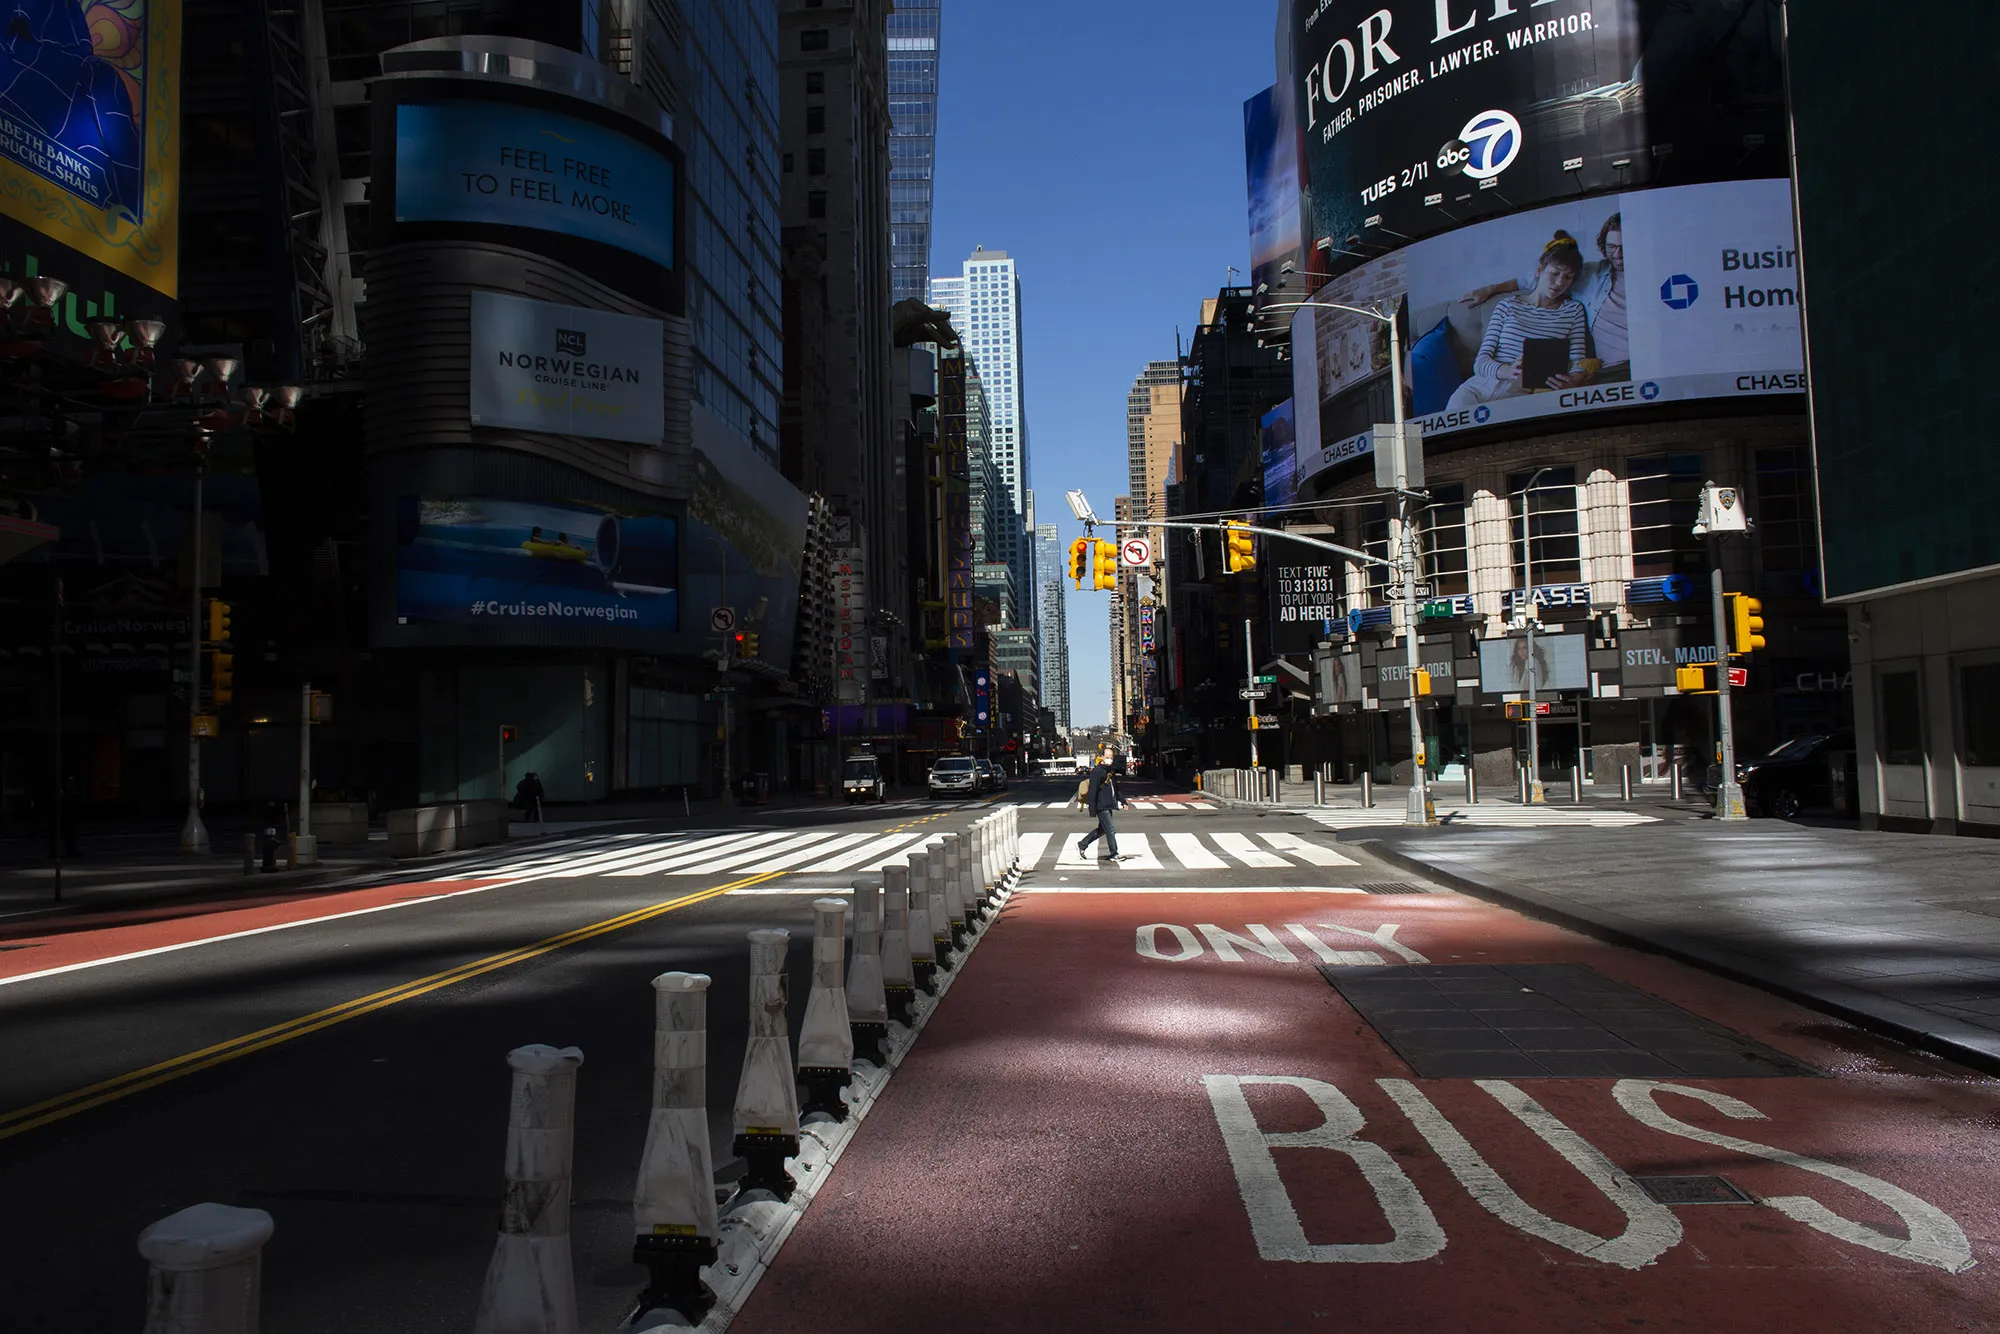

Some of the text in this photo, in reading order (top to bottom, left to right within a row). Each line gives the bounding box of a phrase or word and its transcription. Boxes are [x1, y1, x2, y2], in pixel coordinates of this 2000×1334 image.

[1304, 8, 1401, 133] FOR
[1322, 106, 1356, 144] FATHER.
[1358, 67, 1425, 116] PRISONER.
[1428, 38, 1500, 80] LAWYER.
[1505, 11, 1600, 51] WARRIOR.
[46, 143, 92, 180] BANKS
[500, 146, 612, 189] FEEL FREE
[1436, 146, 1471, 169] abc
[1360, 160, 1429, 206] TUES 2/11
[461, 172, 636, 226] TO FEEL MORE.
[1724, 285, 1801, 309] Hom
[557, 333, 584, 347] NCL
[499, 350, 640, 384] NORWEGIAN
[535, 374, 607, 391] CRUISE LINE
[1559, 385, 1635, 408] CHASE
[944, 360, 965, 473] MADAME
[1323, 441, 1355, 464] CHASE
[1277, 566, 1302, 579] TEXT
[1278, 578, 1335, 593] TO 313131
[470, 600, 639, 622] #CruiseNorwegian
[1280, 592, 1334, 606] TO PUT YOUR
[1280, 605, 1335, 622] AD HERE!
[839, 551, 854, 681] AMSTERDAM
[1135, 923, 1431, 965] ONLY
[1203, 1074, 1975, 1275] BUS
